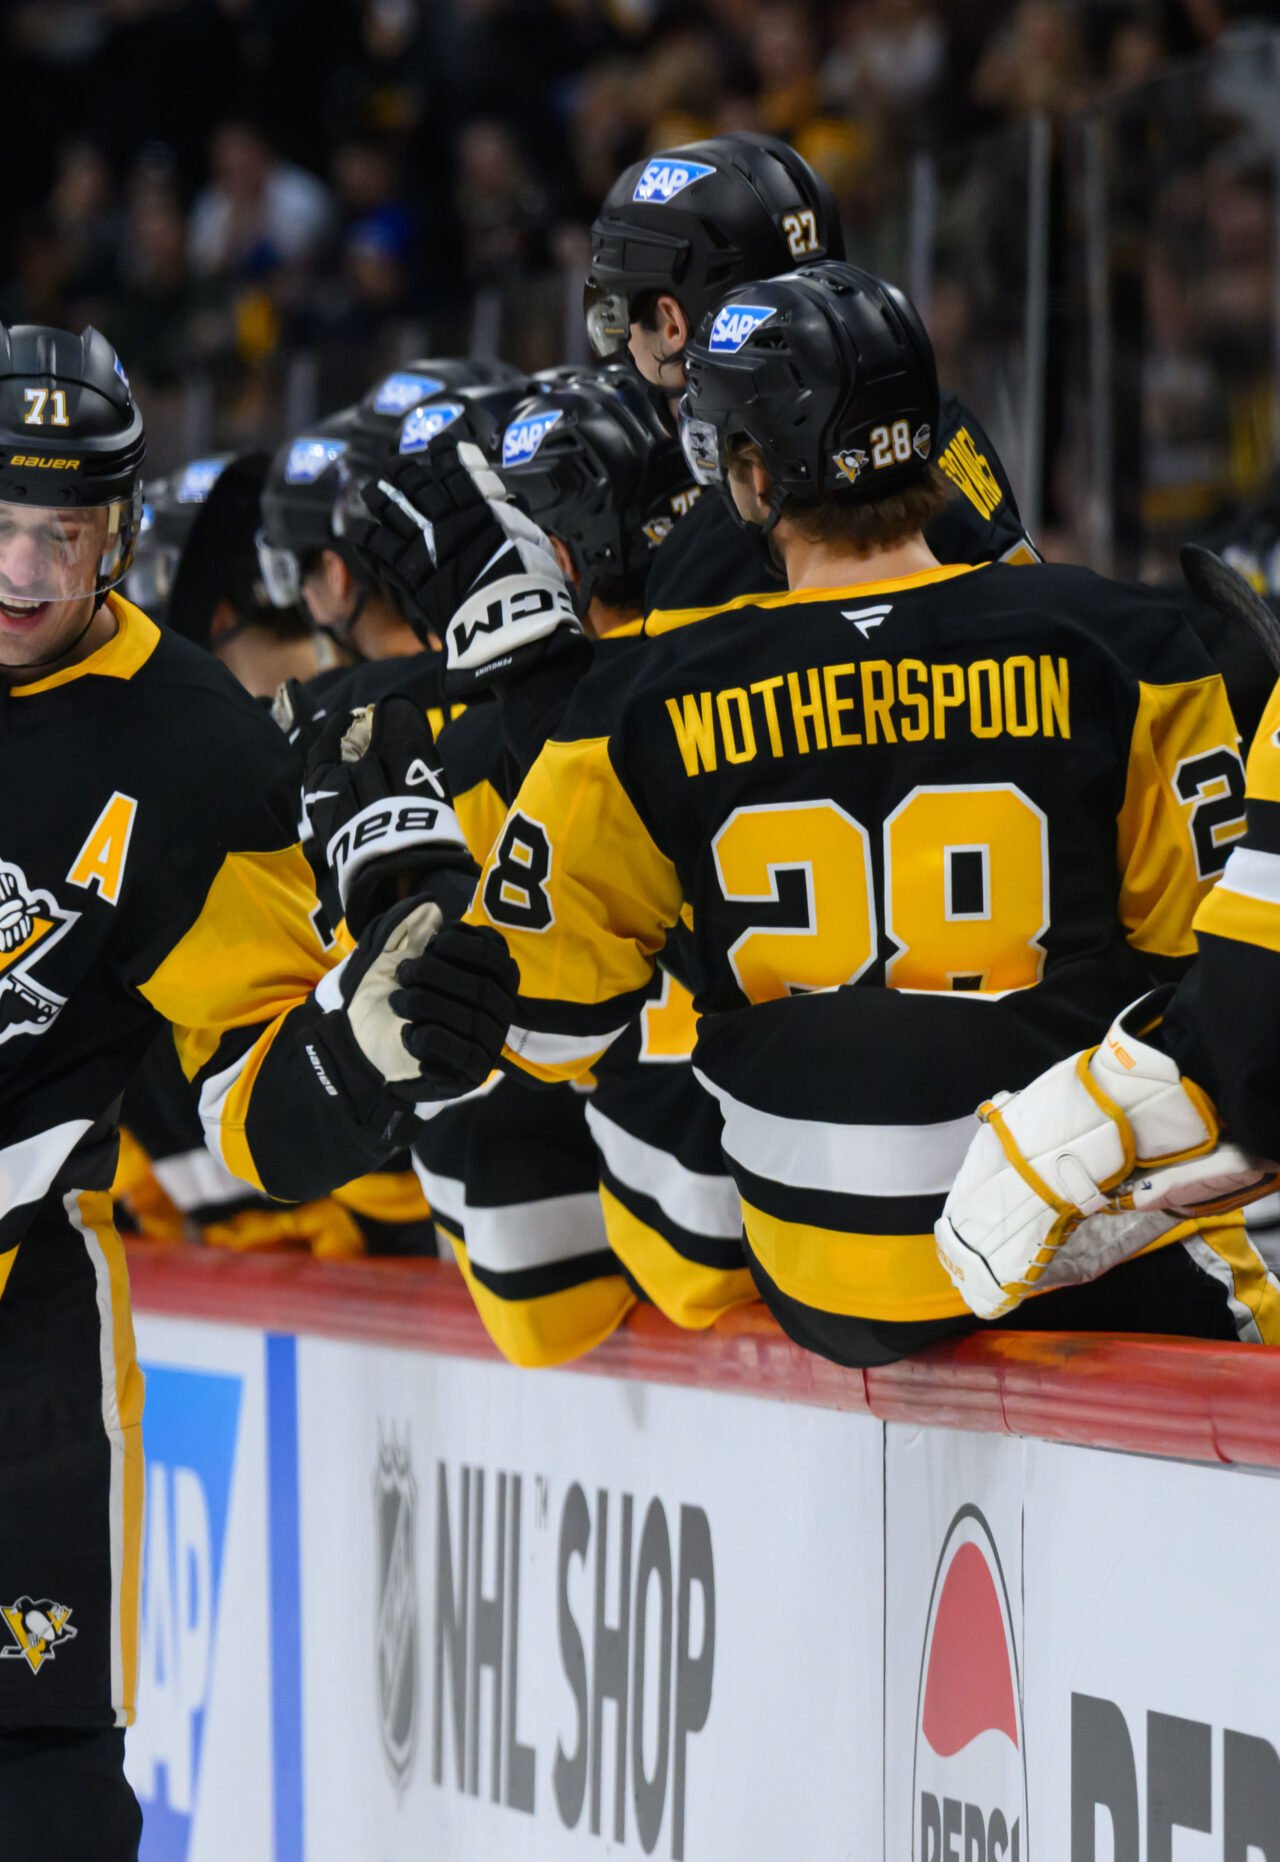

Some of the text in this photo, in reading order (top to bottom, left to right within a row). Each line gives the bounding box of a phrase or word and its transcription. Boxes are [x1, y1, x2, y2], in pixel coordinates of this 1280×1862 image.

[638, 166, 689, 198] SAP
[782, 210, 819, 255] 27
[712, 310, 752, 342] SAP
[24, 388, 69, 426] 71
[504, 423, 542, 457] SAP
[870, 419, 911, 469] 28
[475, 657, 512, 678] PENGUINS
[665, 655, 1071, 777] WOTHERSPOON
[65, 790, 138, 907] A
[711, 782, 1051, 1005] 28
[432, 1459, 537, 1816] NHL
[552, 1480, 716, 1862] SHOP
